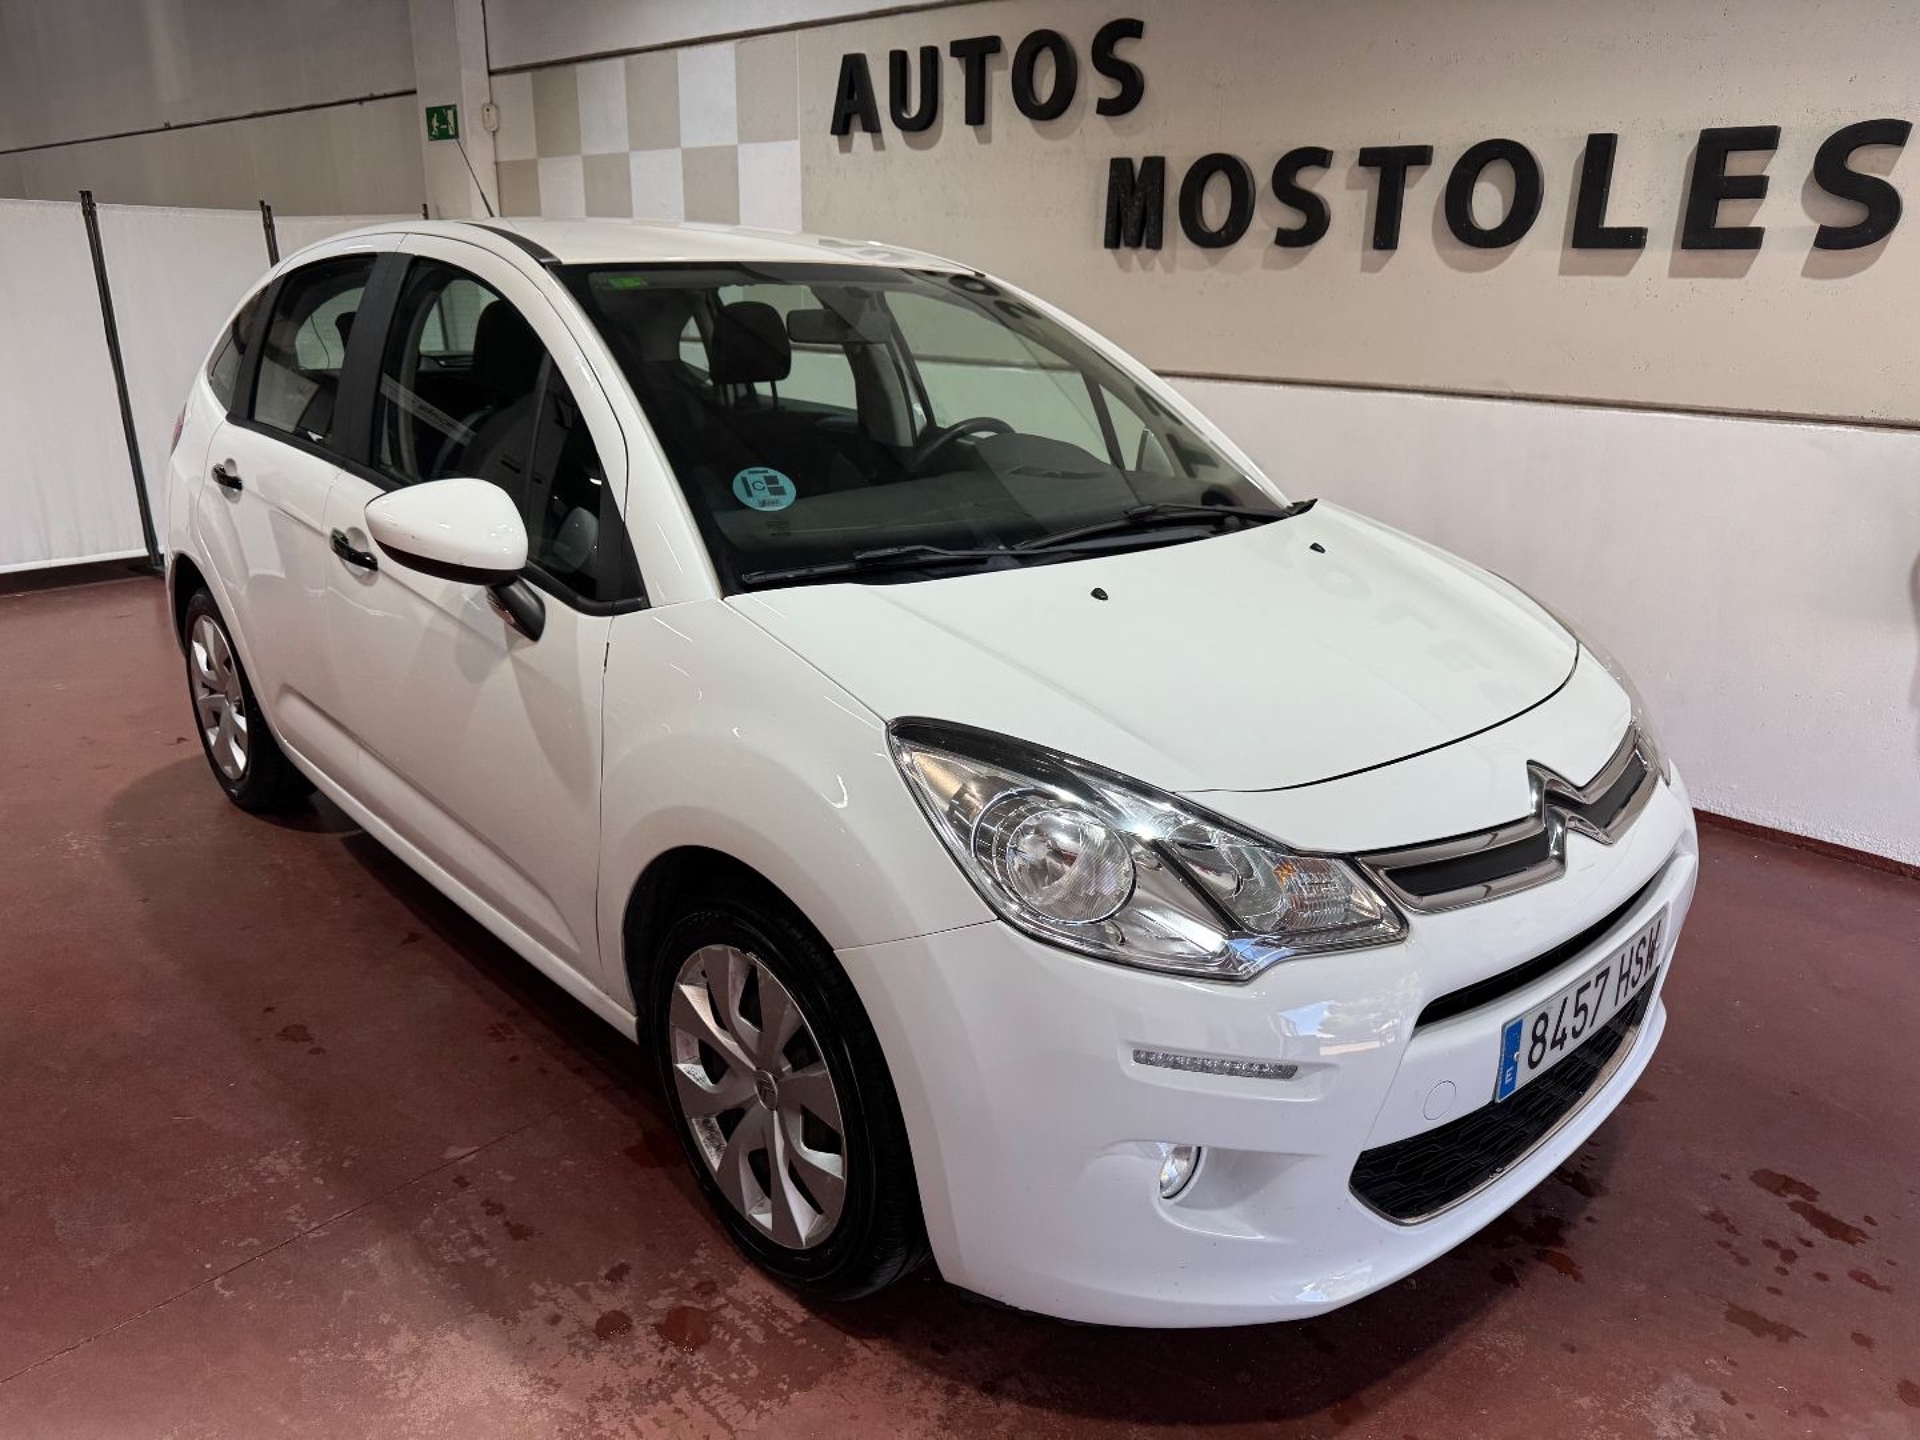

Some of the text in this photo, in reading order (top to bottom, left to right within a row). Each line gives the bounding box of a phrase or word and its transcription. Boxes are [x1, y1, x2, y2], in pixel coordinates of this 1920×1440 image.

[830, 18, 1145, 137] AUTOS
[1104, 118, 1913, 251] MOSTOLES
[1527, 919, 1662, 1071] 8457 HSW
[1504, 1069, 1513, 1084] E
